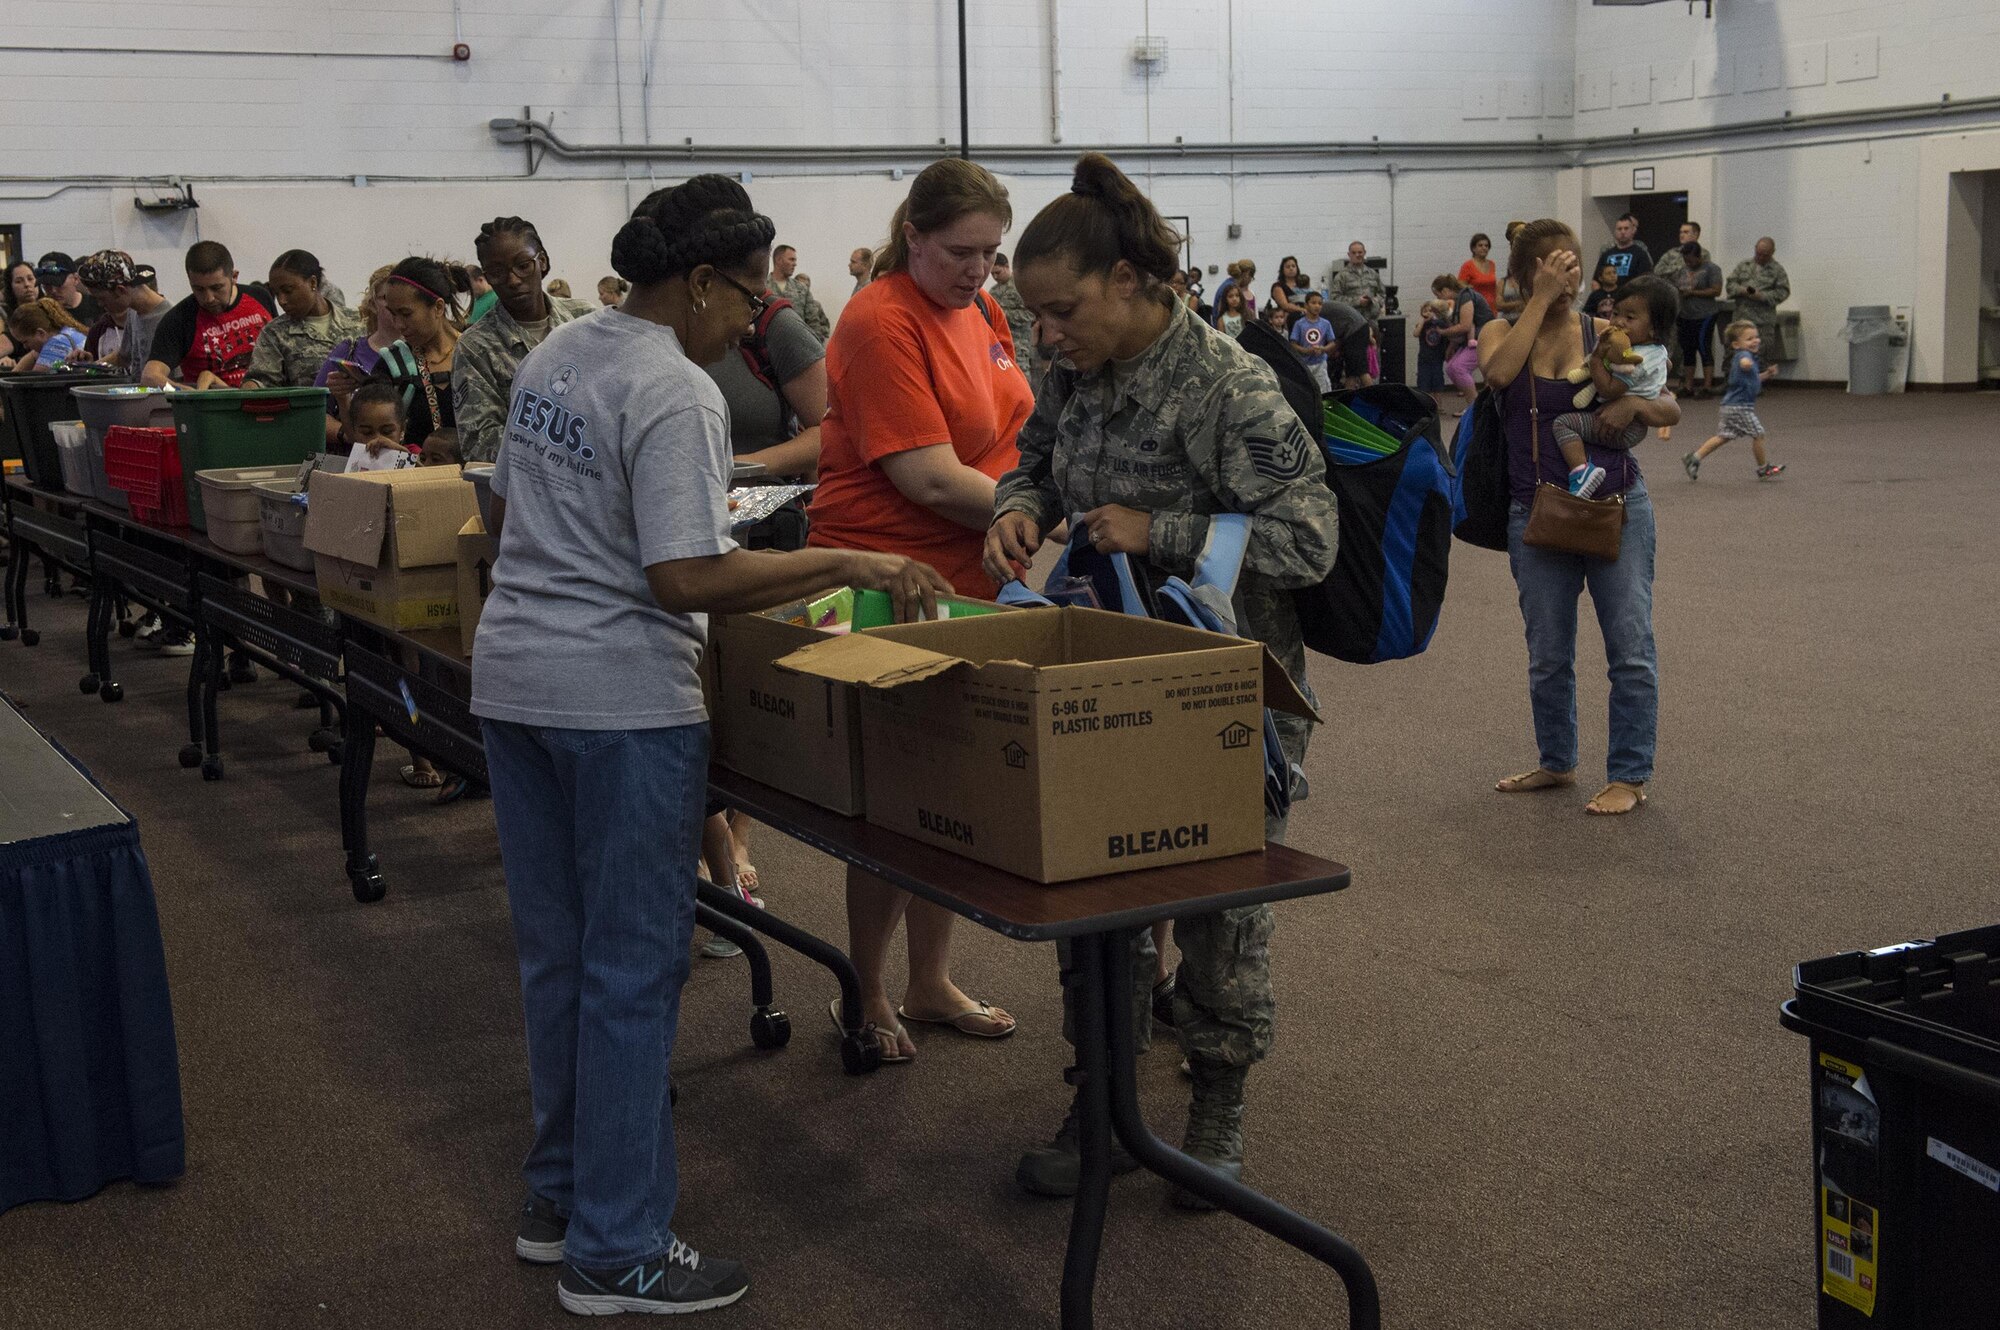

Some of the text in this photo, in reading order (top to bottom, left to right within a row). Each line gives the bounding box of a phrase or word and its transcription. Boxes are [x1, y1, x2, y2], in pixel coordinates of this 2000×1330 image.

[206, 313, 263, 337] CALIFORNIA
[548, 451, 566, 467] my
[1113, 458, 1187, 477] U.S. AIR FORCE
[427, 604, 452, 617] FASH
[1165, 680, 1257, 699] DO NOT STACK OVER 6 HIGH
[749, 688, 795, 720] BLEACH
[1052, 698, 1098, 717] 6-96 OZ
[1181, 693, 1258, 711] DO NOT DOUBLE STACK
[1052, 710, 1153, 735] PLASTIC BOTTLES
[1228, 728, 1246, 744] UP
[1009, 748, 1022, 764] UP
[918, 808, 975, 845] BLEACH
[1108, 823, 1209, 859] BLEACH
